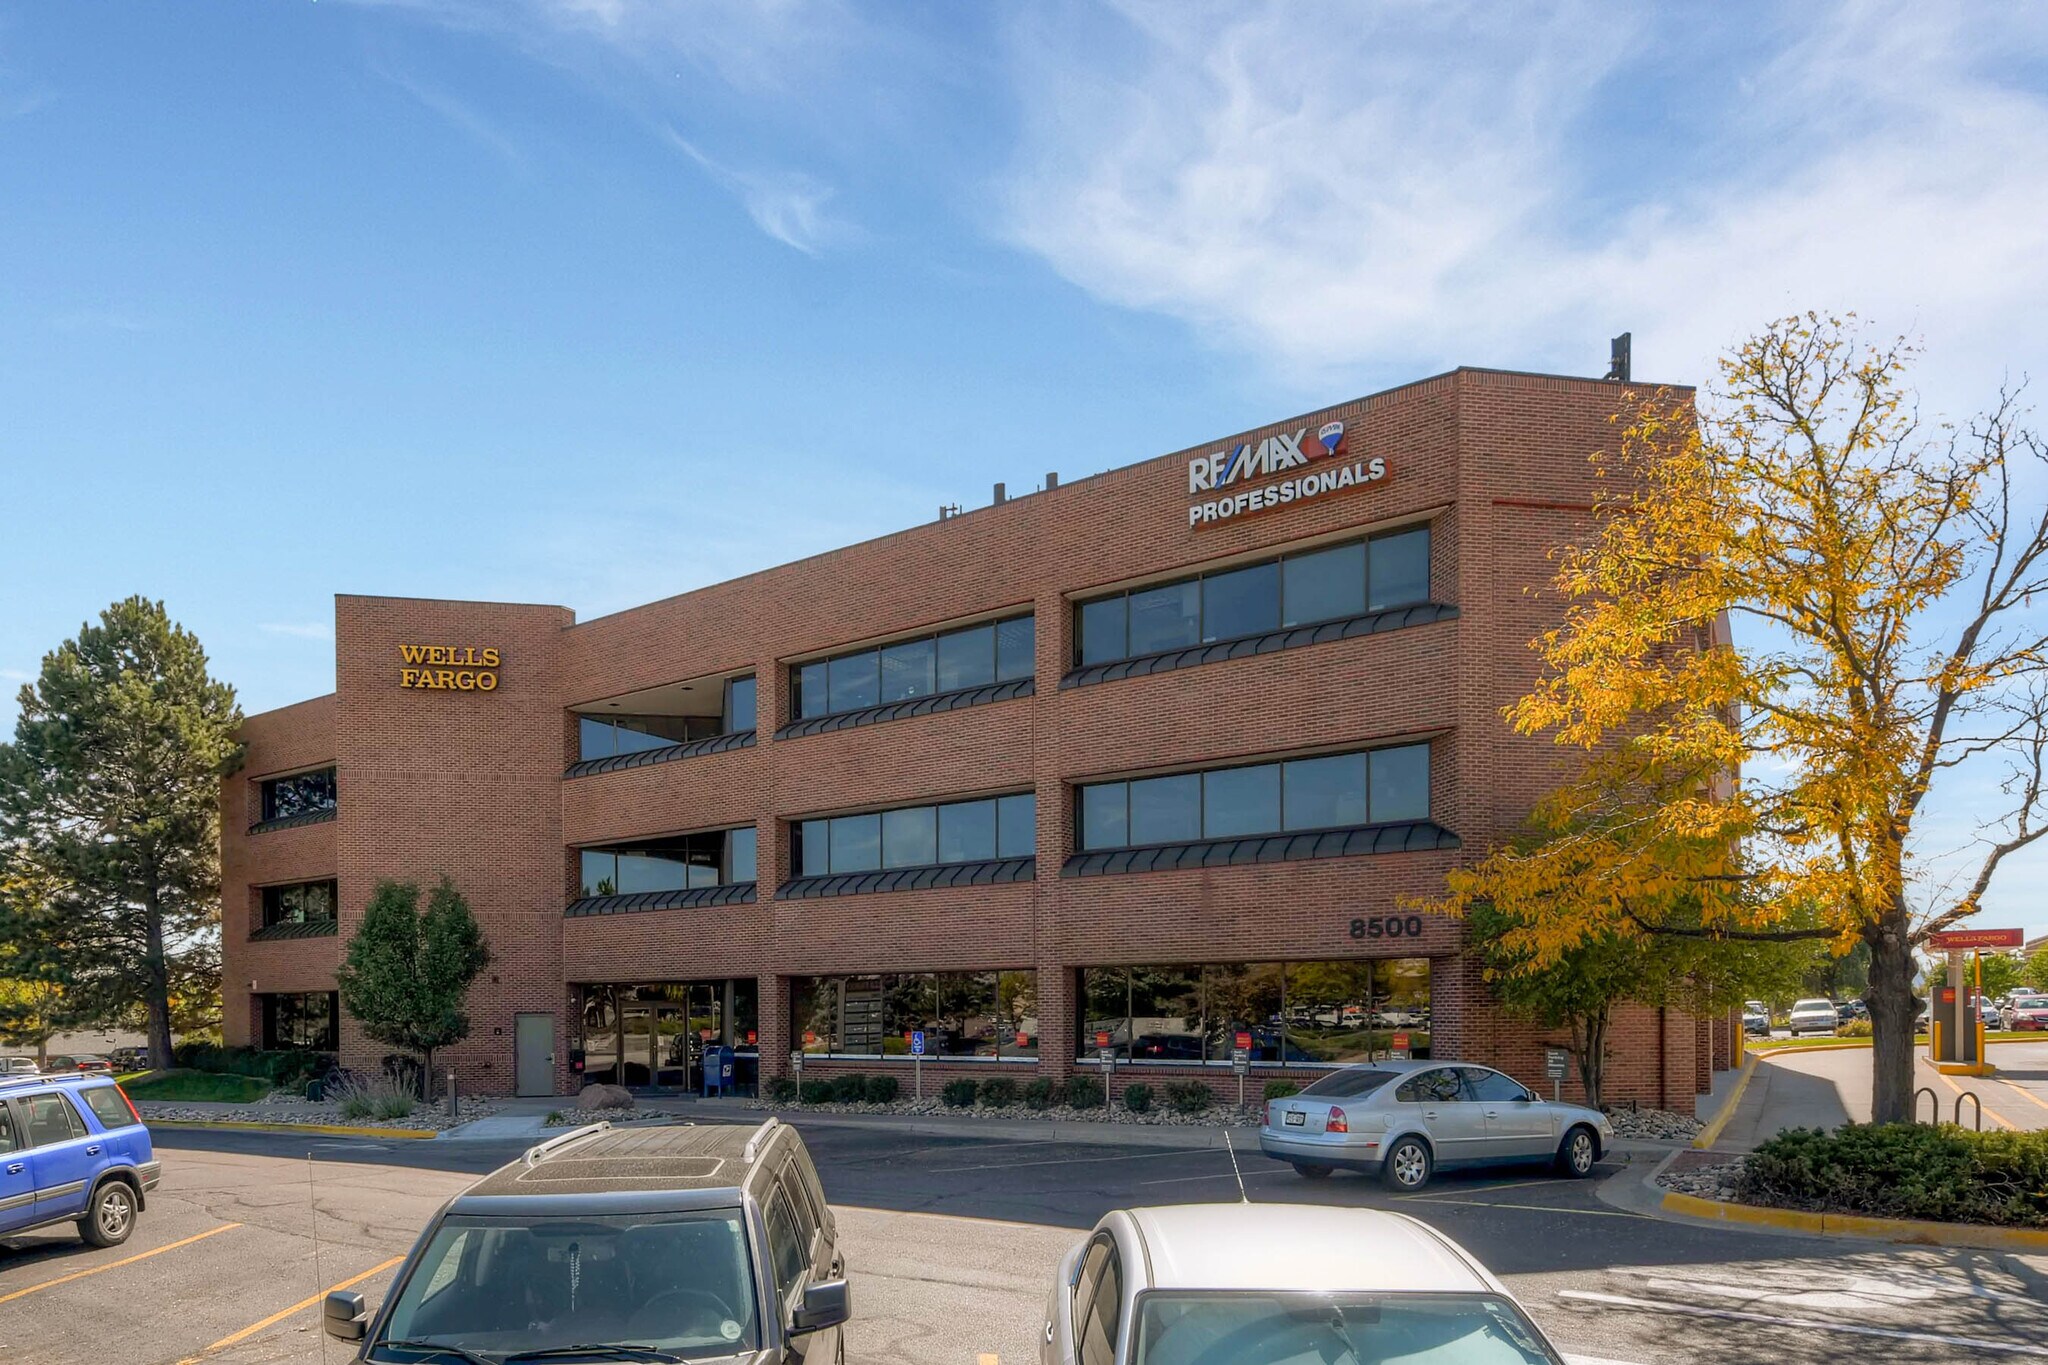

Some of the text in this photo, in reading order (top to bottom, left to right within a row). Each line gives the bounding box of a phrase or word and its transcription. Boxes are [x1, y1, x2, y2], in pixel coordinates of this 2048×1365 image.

[1189, 428, 1309, 494] RE/MAX
[1189, 457, 1386, 528] PROFESSIONALS
[398, 644, 501, 667] WELLS
[400, 668, 498, 691] FARGO
[1350, 915, 1422, 939] 8500
